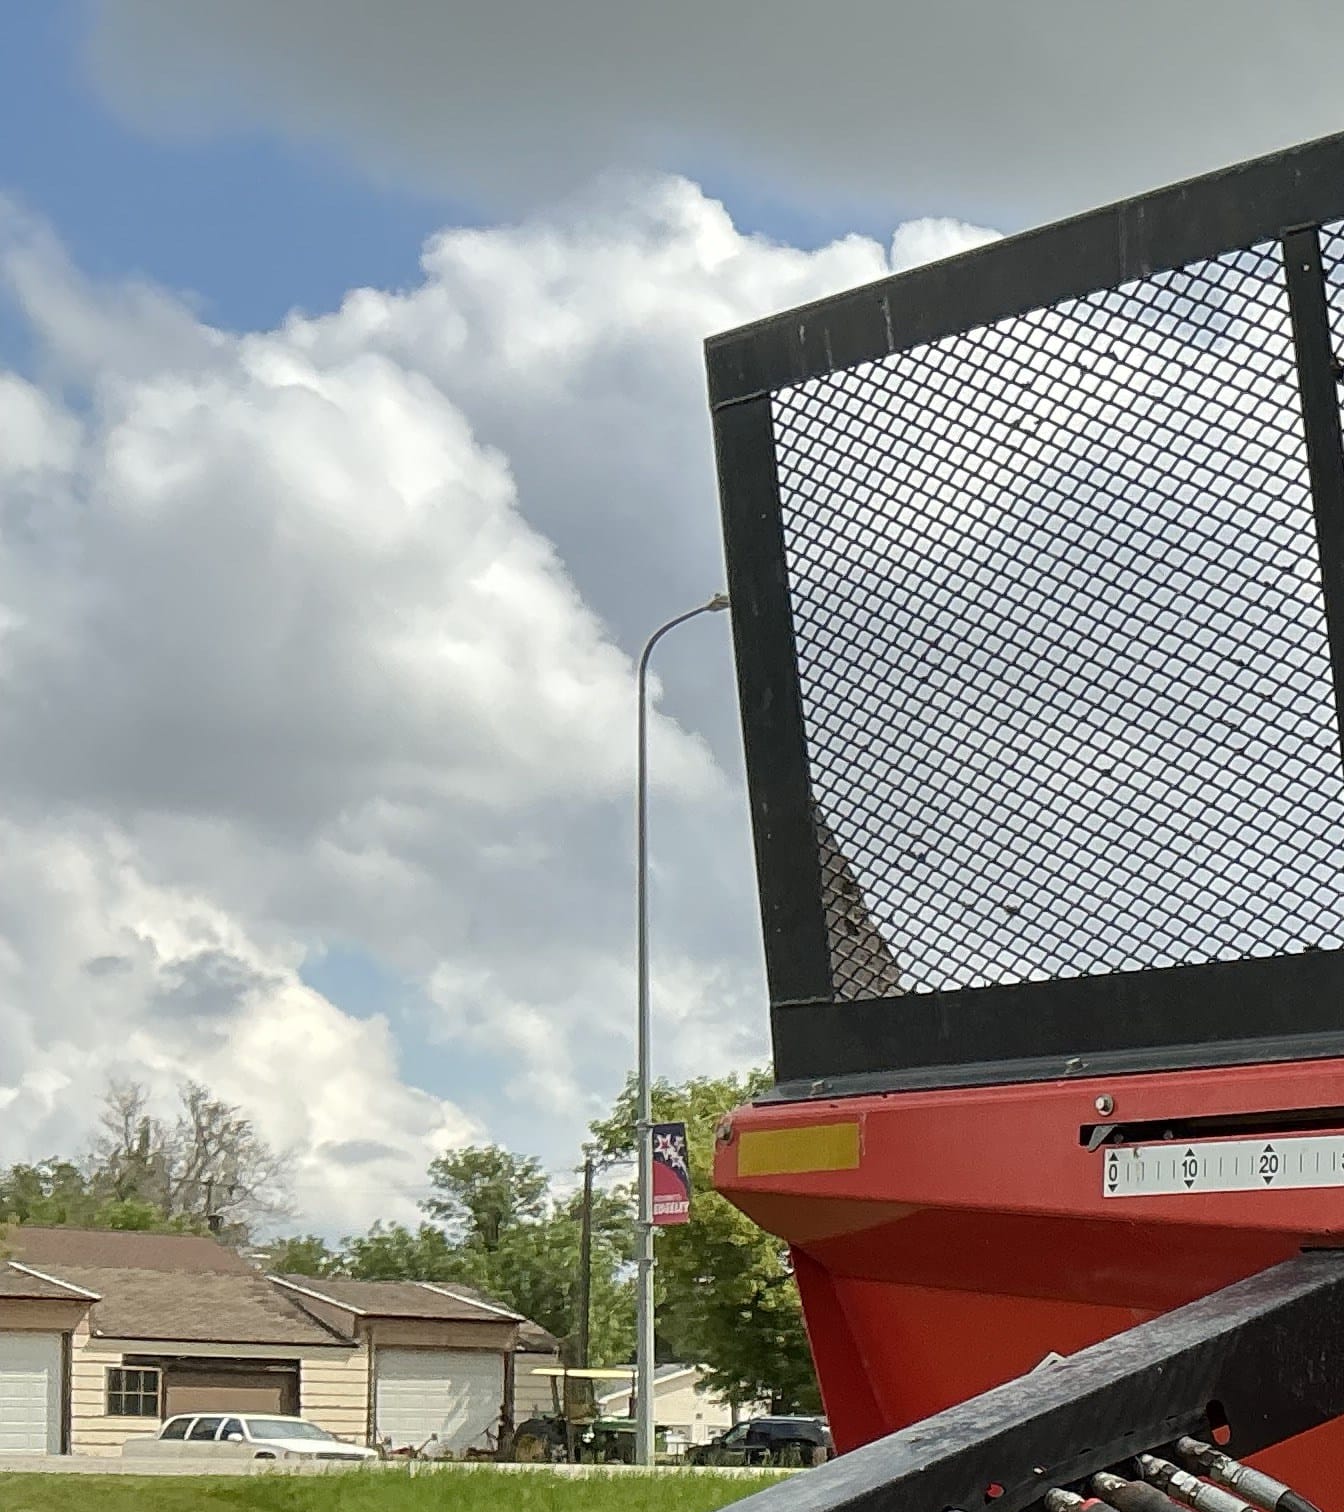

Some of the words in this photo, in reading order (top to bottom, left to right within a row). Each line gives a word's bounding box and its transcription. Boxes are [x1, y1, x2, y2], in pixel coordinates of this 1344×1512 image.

[1108, 1163, 1118, 1182] 0
[1181, 1159, 1198, 1178] 10
[1259, 1154, 1279, 1174] 20
